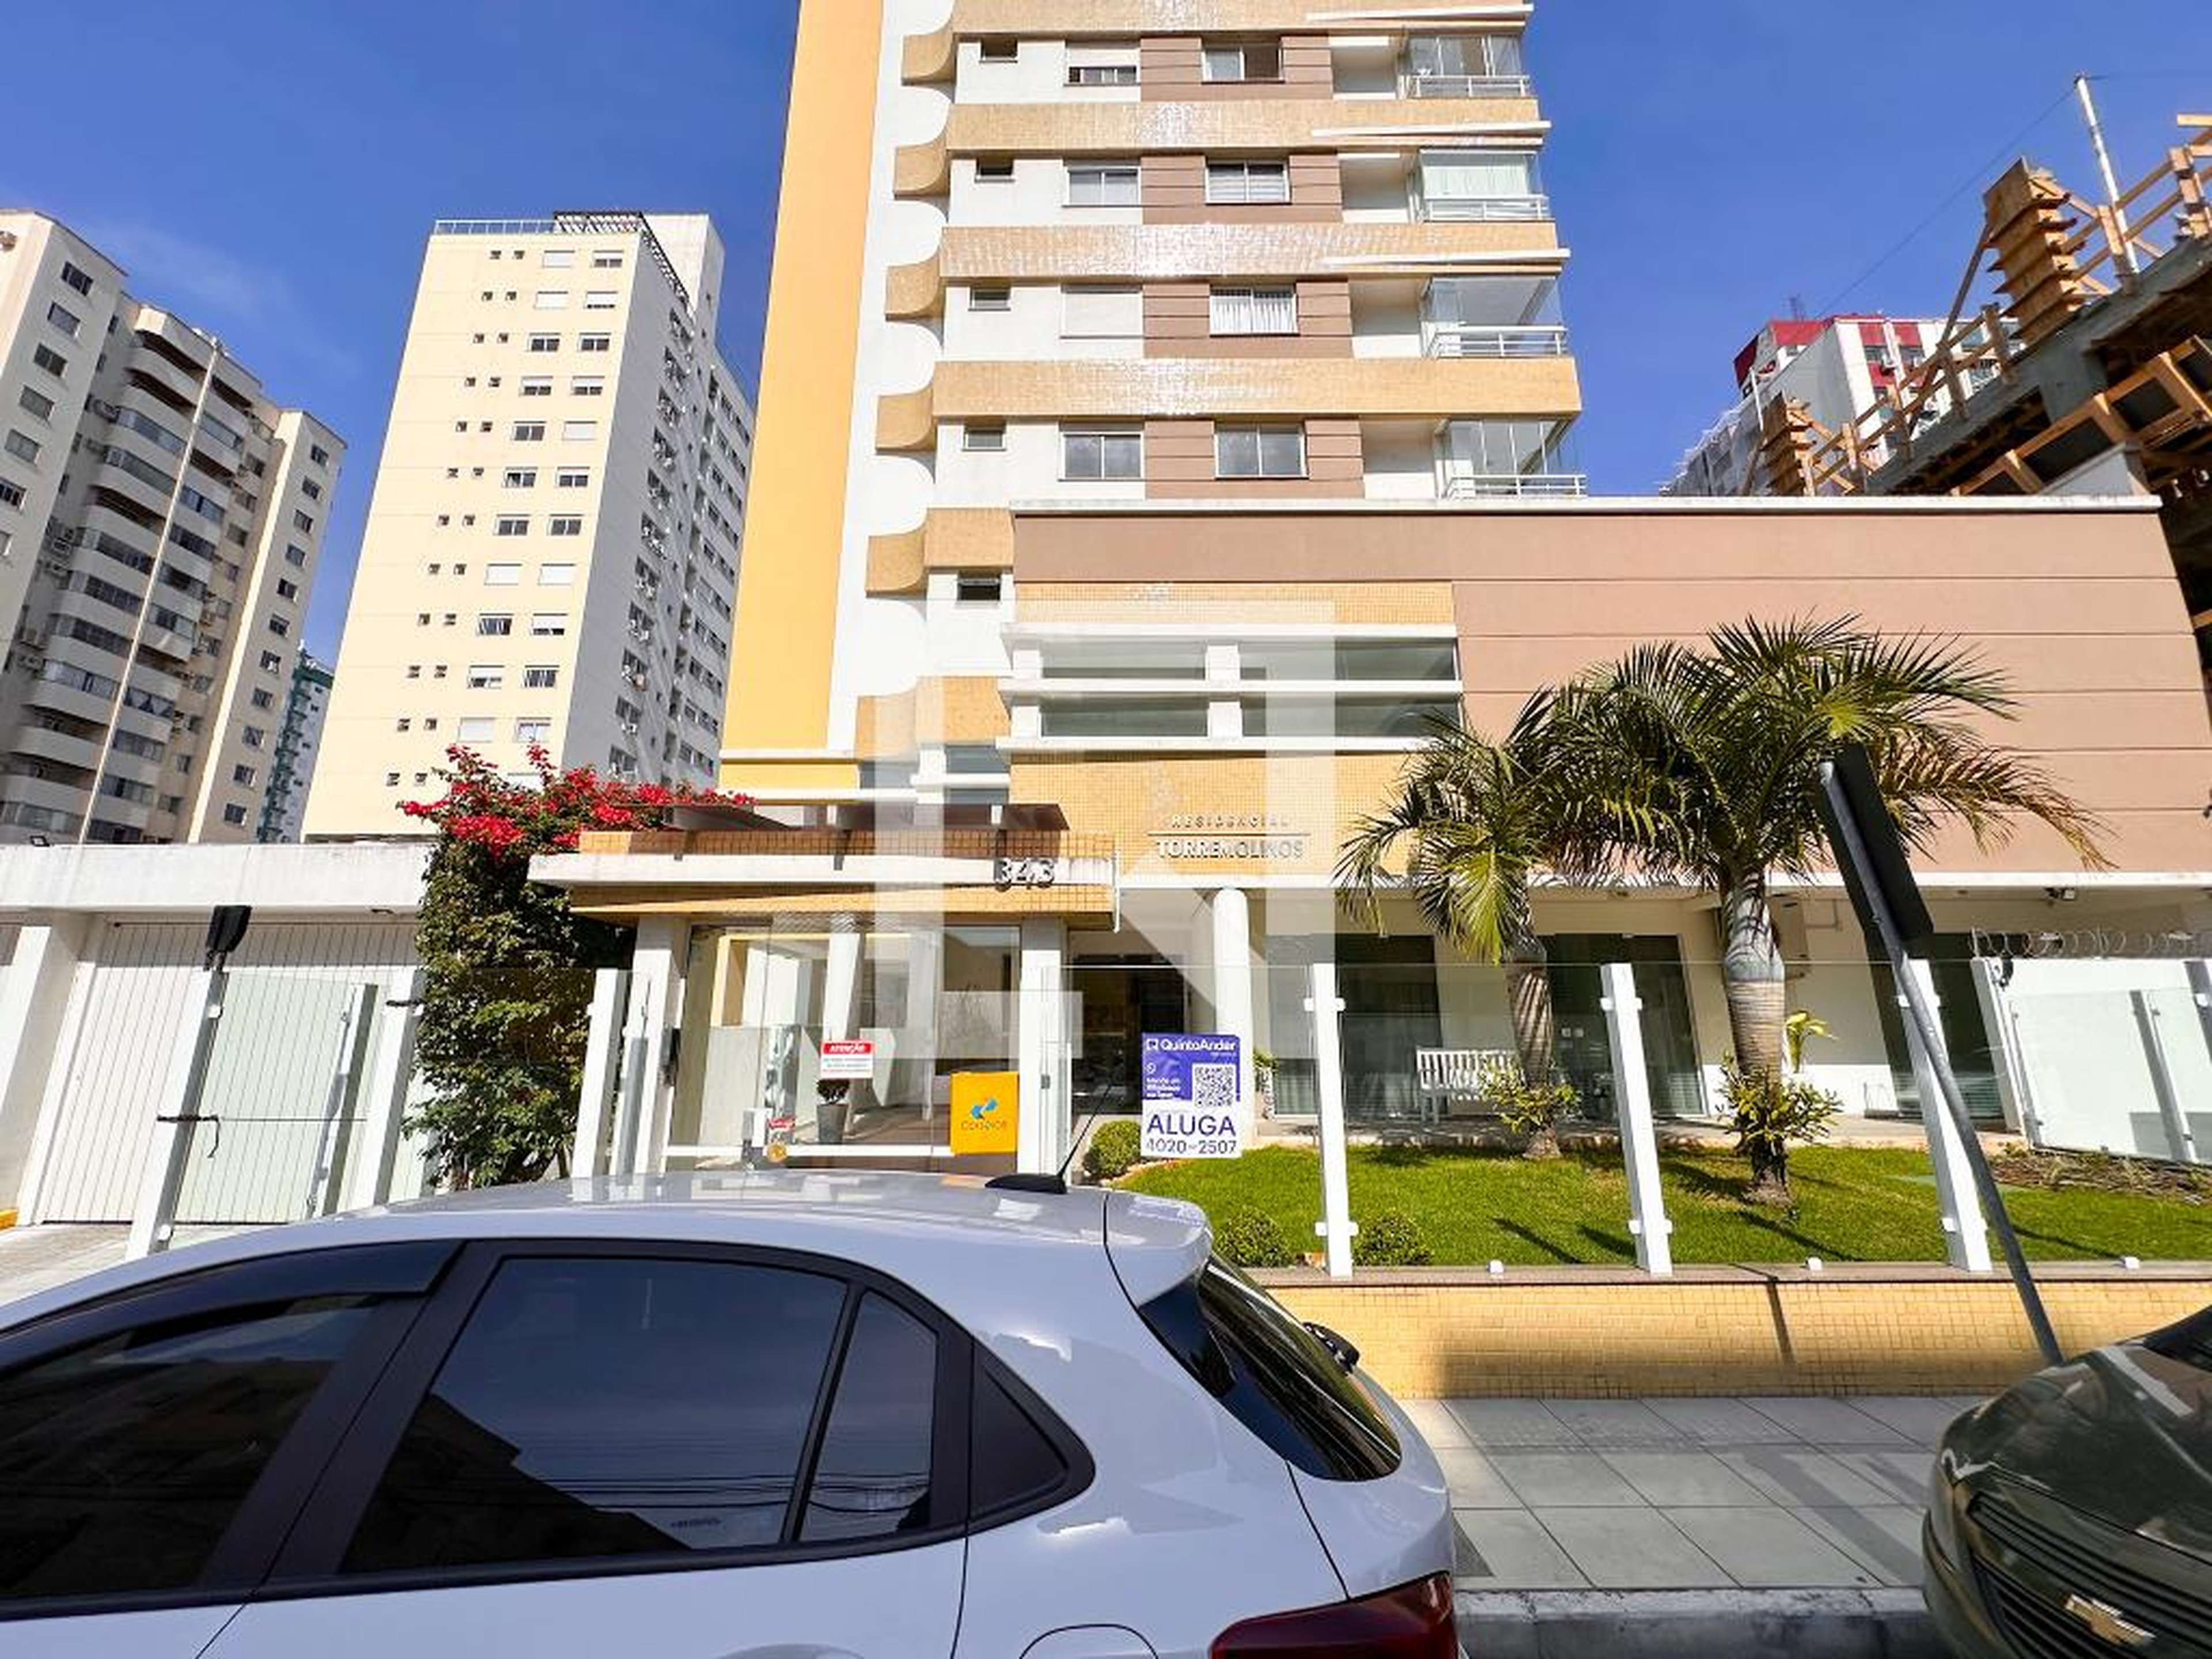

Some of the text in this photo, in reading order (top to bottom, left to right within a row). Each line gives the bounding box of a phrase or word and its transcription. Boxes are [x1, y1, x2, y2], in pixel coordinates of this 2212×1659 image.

[1172, 815, 1289, 828] RESIDENCIAL
[1156, 840, 1304, 858] TORREMOLINOS
[994, 857, 1055, 891] 343
[1147, 1114, 1236, 1137] ALUGA
